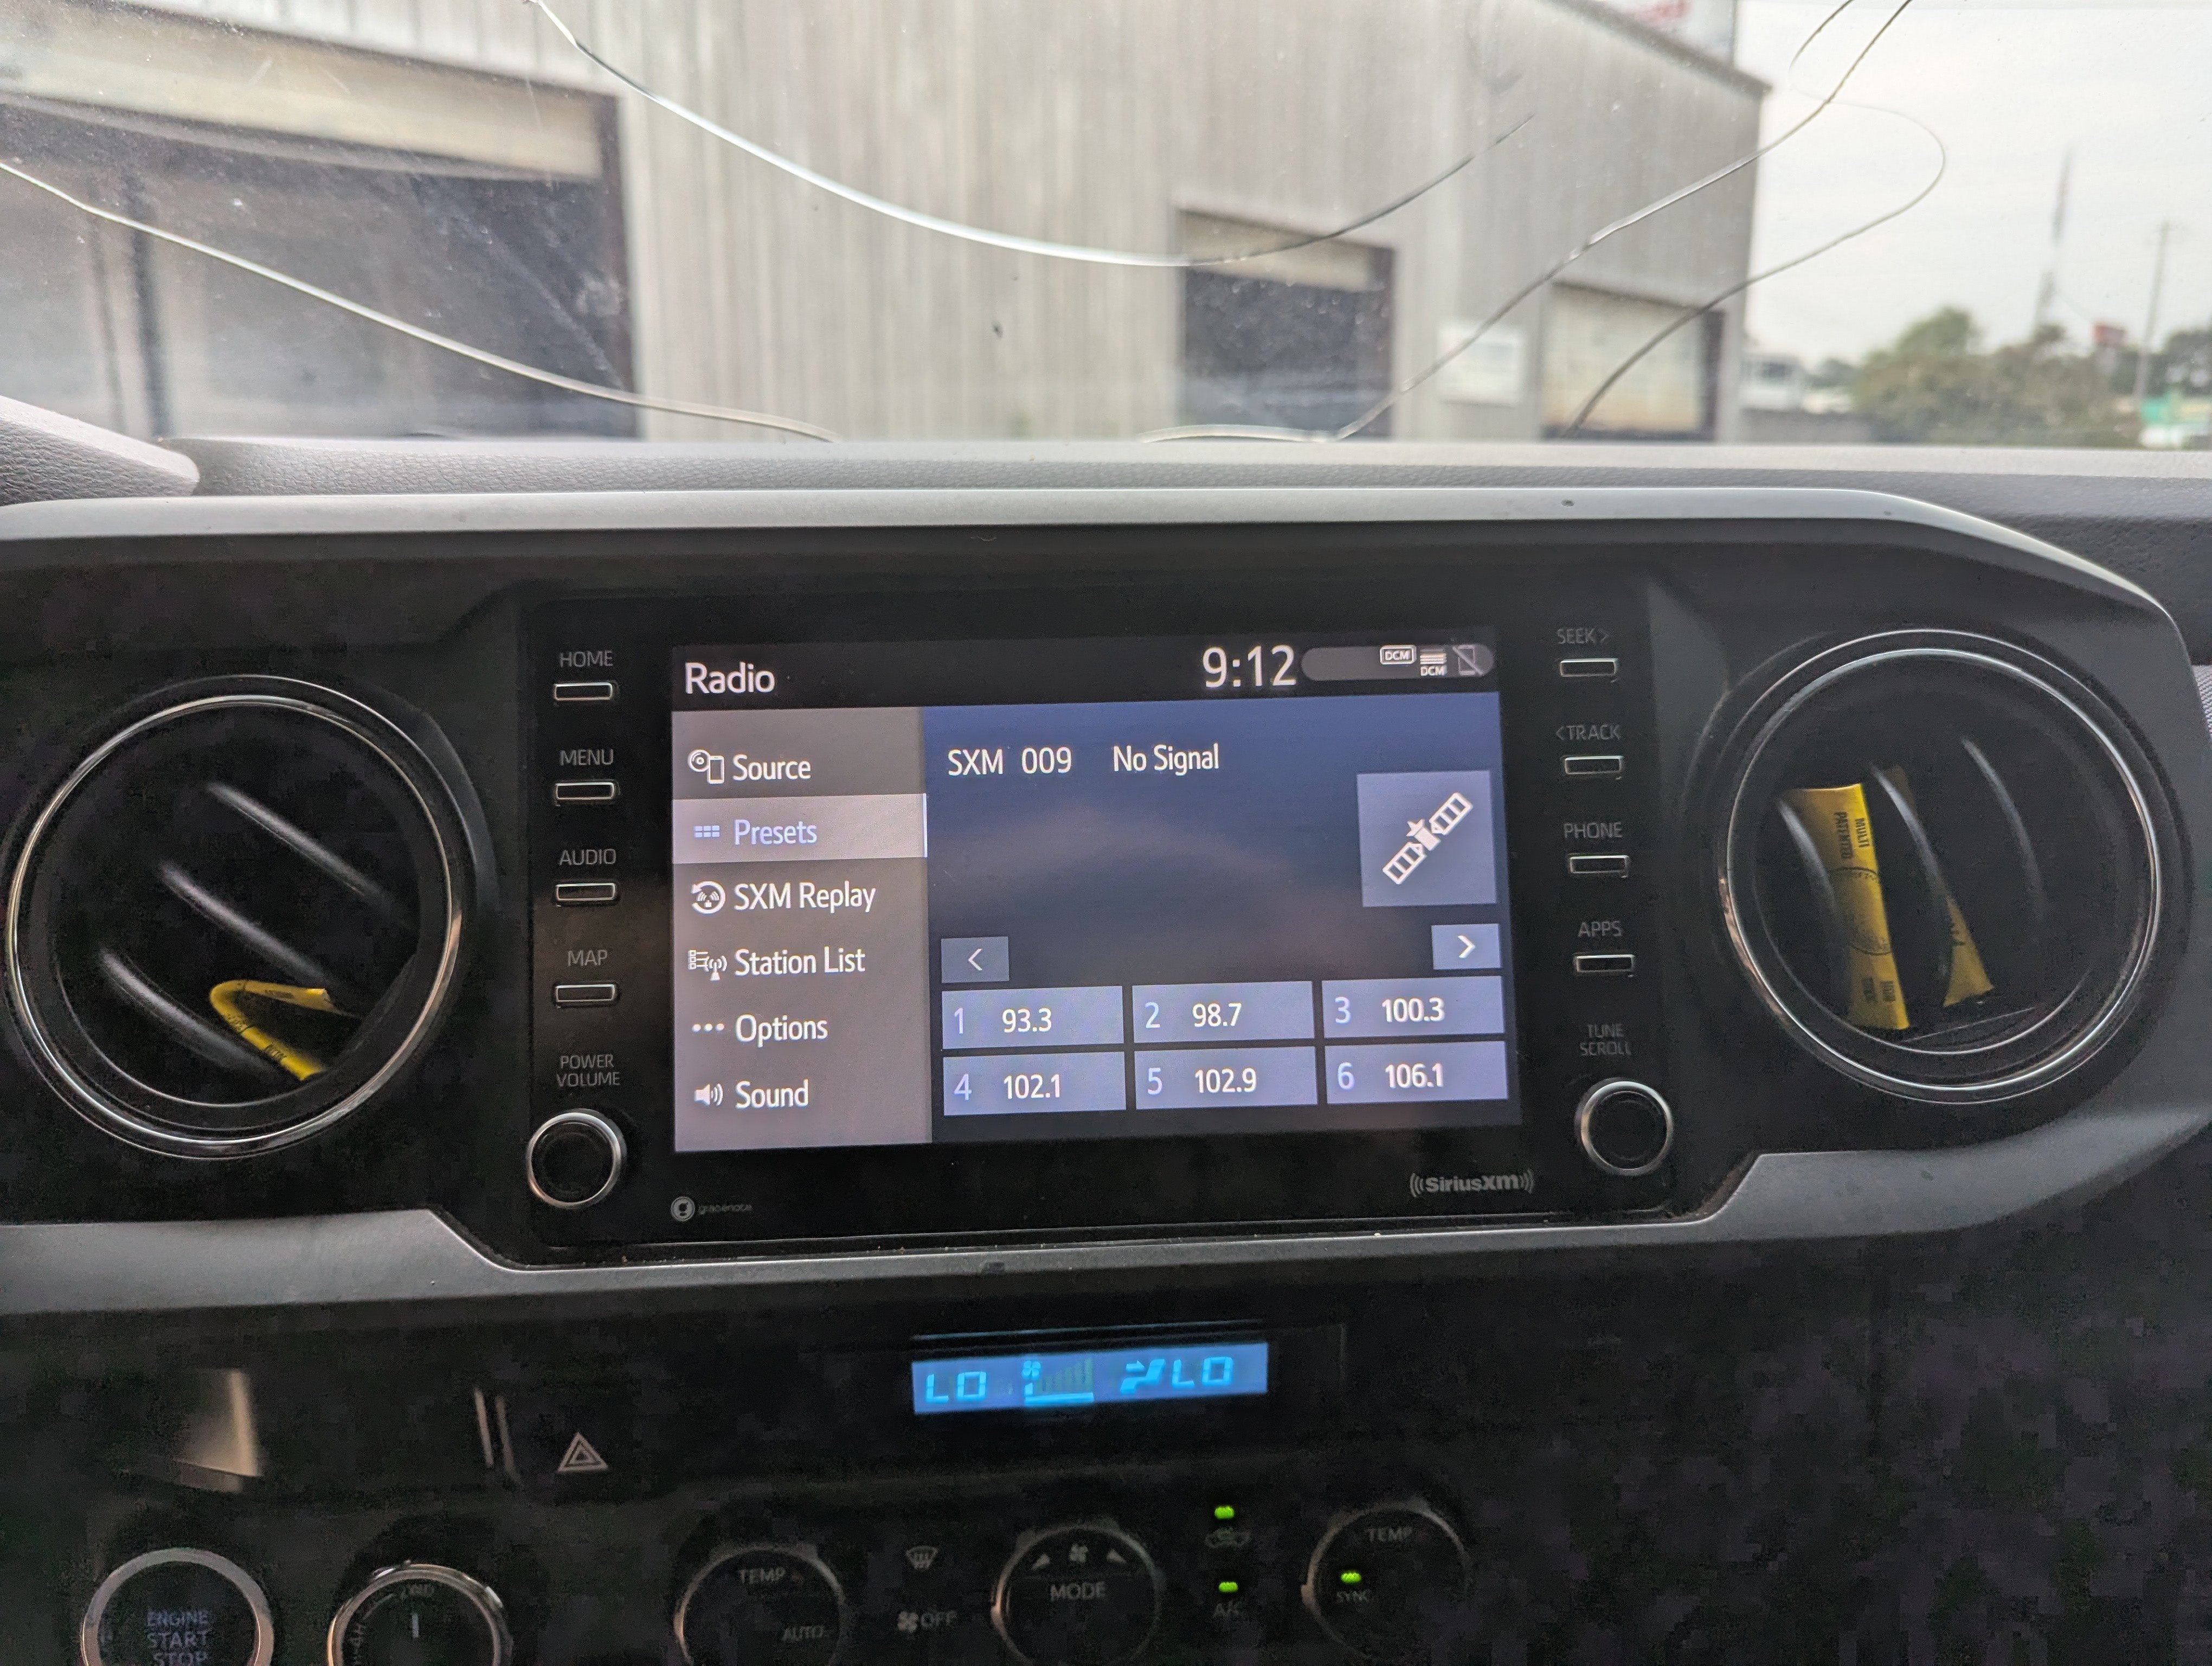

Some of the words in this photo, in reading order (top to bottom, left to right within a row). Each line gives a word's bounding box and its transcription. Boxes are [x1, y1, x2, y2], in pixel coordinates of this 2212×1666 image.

[560, 650, 613, 668] HOME
[1202, 644, 1297, 688] 9:12
[1384, 650, 1410, 661] DCM
[684, 662, 776, 694] Radio
[1420, 667, 1444, 676] DCM
[560, 749, 614, 766] MENU
[732, 754, 812, 781] Source
[948, 749, 1004, 776] SXM
[1021, 747, 1072, 773] 009
[1113, 745, 1147, 772] No
[1153, 743, 1219, 777] Signal
[734, 819, 818, 845] Presets
[1564, 823, 1623, 838] PHONE
[1855, 818, 1870, 847] MULTI
[559, 849, 616, 866] AUDIO
[734, 883, 792, 911] SXM
[799, 881, 876, 913] Replay
[1578, 921, 1623, 938] APPS
[567, 950, 608, 966] MAP
[735, 950, 816, 977] Station
[824, 946, 866, 973] List
[954, 1008, 965, 1034] 1
[1002, 1008, 1052, 1033] 93.3
[1145, 1002, 1161, 1029] 2
[1192, 1003, 1242, 1028] 98.7
[1335, 997, 1351, 1024] 3
[1381, 998, 1444, 1023] 100.3
[736, 1014, 828, 1047] Options
[1586, 1023, 1623, 1038] TUNE
[1580, 1042, 1631, 1056] SCROLL
[560, 1055, 614, 1069] POWER
[556, 1072, 620, 1087] VOLUME
[1147, 1068, 1162, 1094] 5
[1194, 1068, 1257, 1093] 102.9
[1337, 1062, 1355, 1090] 6
[1385, 1062, 1444, 1089] 106.1
[736, 1080, 809, 1110] Sound
[954, 1074, 972, 1100] 4
[1004, 1074, 1061, 1099] 102.1
[1171, 1356, 1234, 1387] LO
[925, 1371, 988, 1403] LO
[1367, 1527, 1413, 1543] TEMP
[739, 1567, 785, 1584] TEMP
[1050, 1581, 1107, 1602] MODE
[147, 1610, 209, 1627] ENGINE
[920, 1612, 957, 1628] OFF
[147, 1631, 209, 1650] START
[782, 1624, 824, 1641] AUTO
